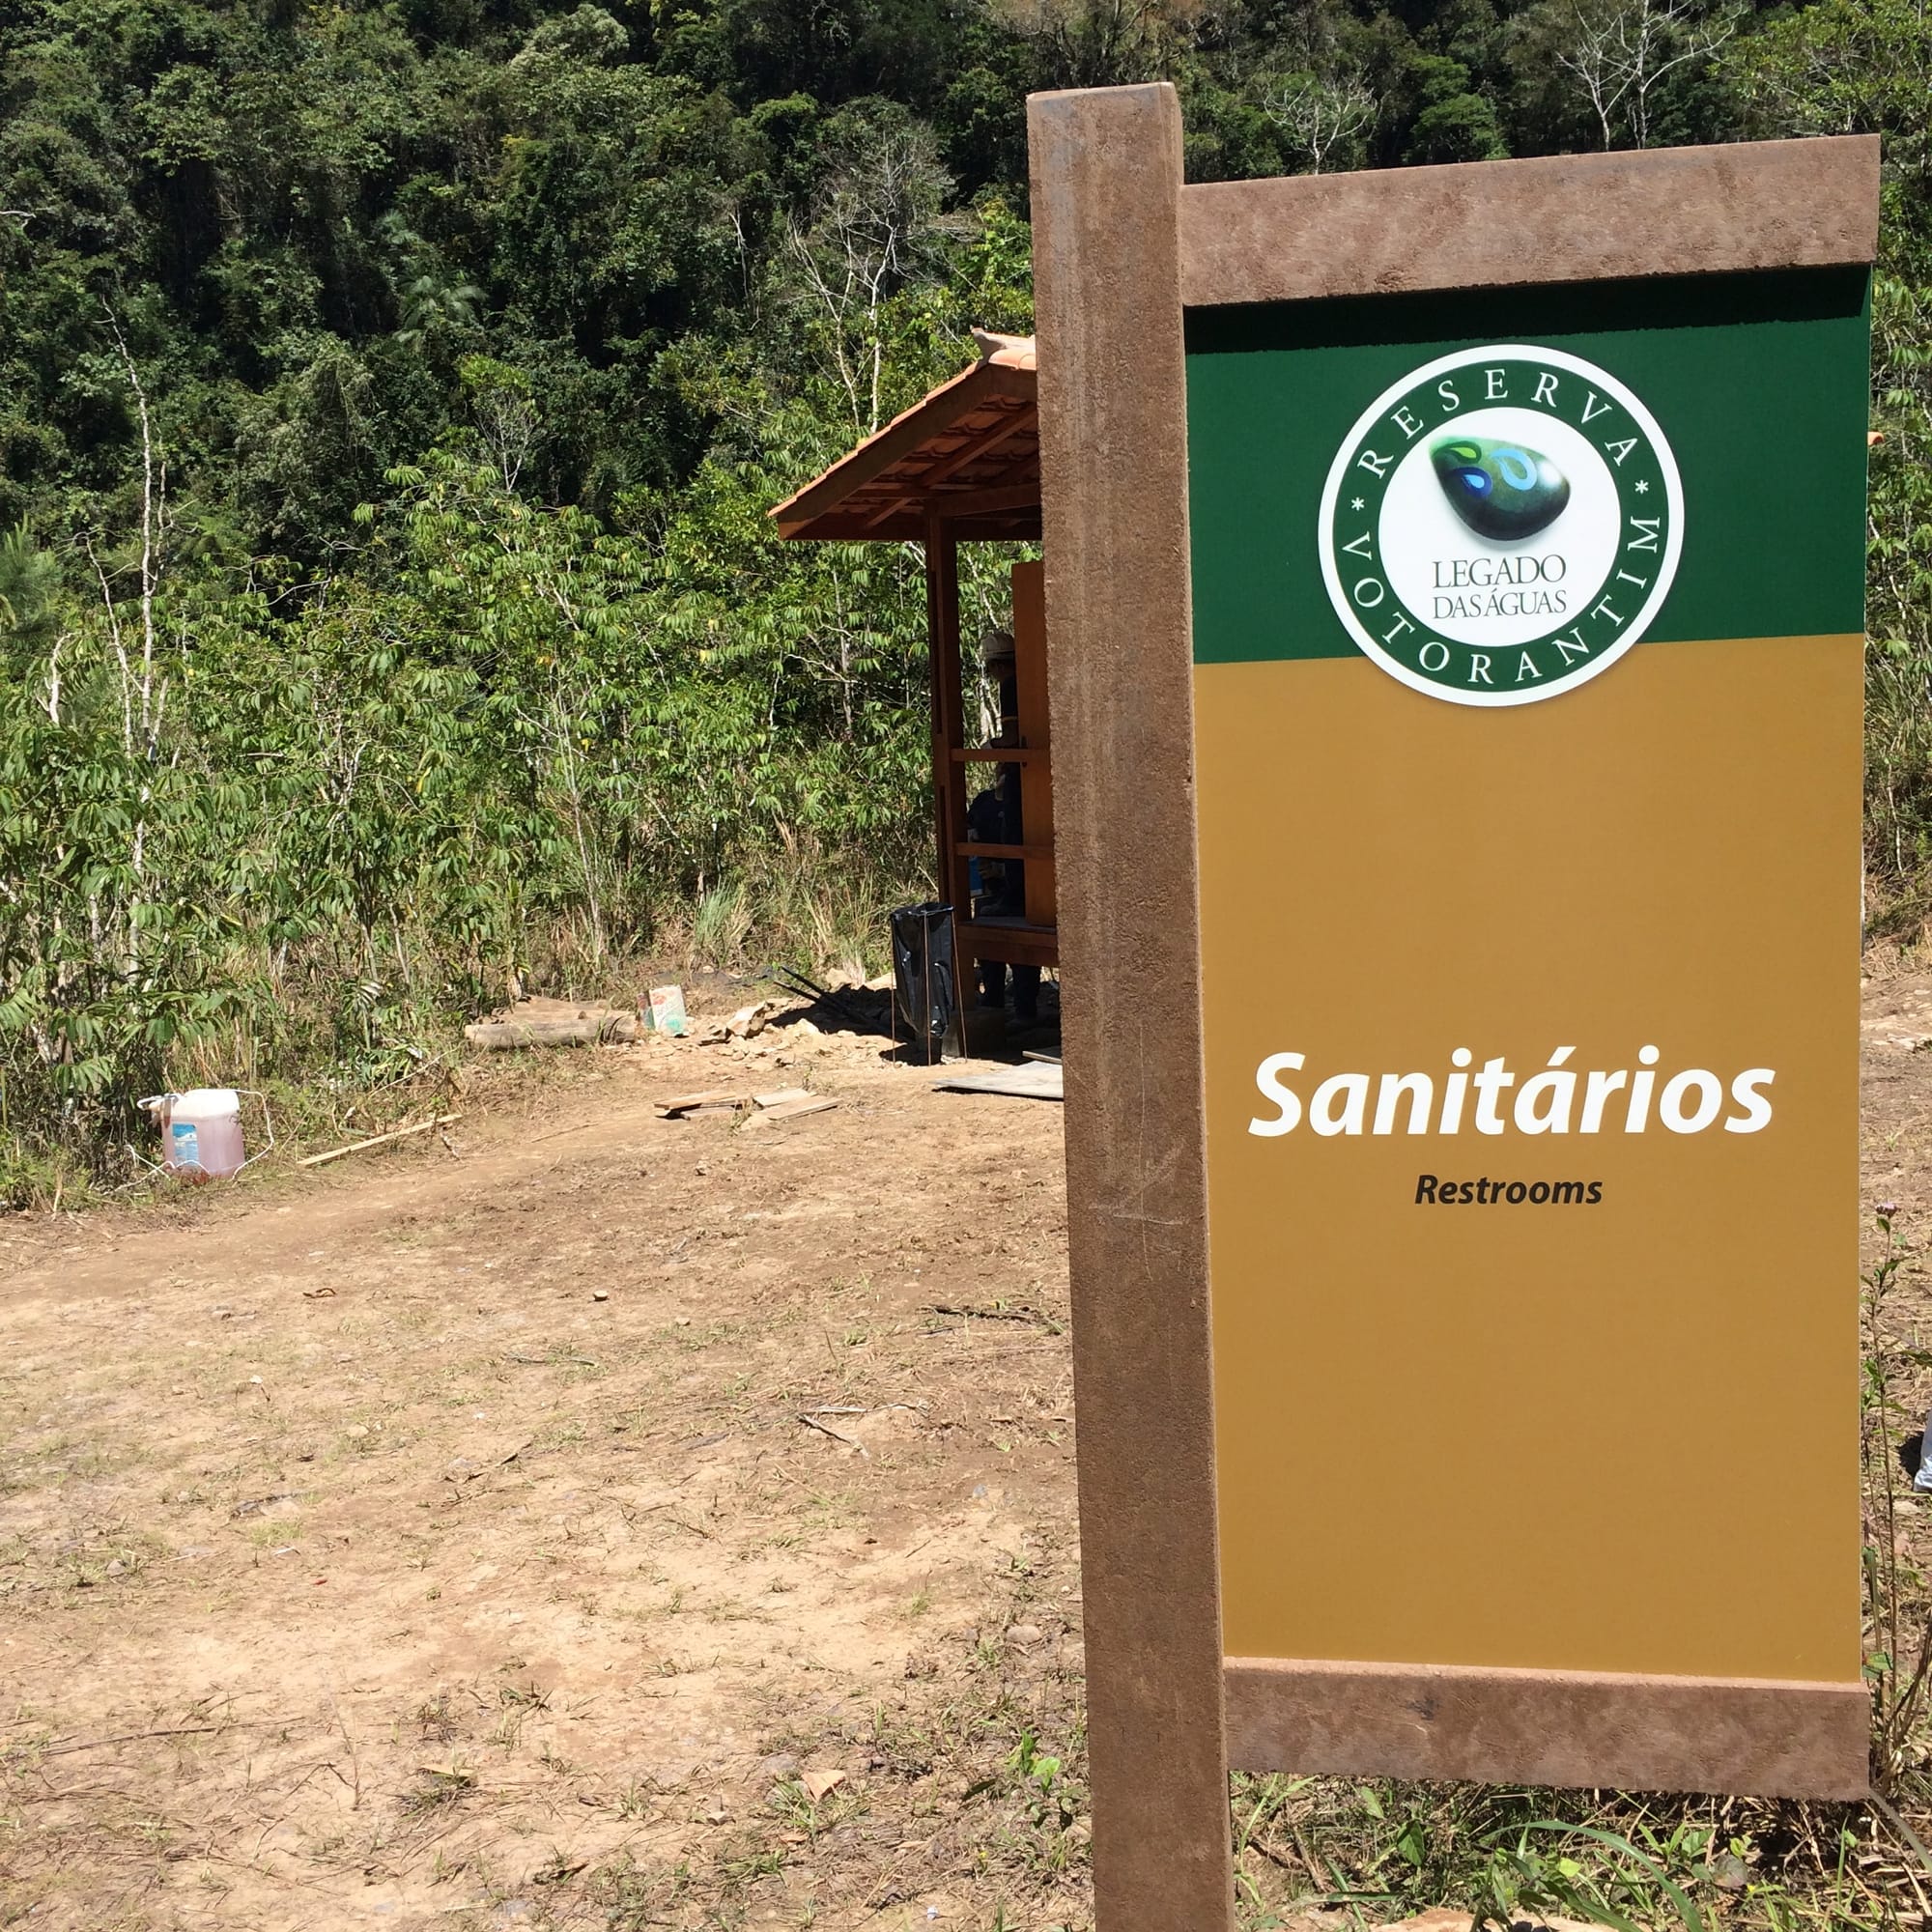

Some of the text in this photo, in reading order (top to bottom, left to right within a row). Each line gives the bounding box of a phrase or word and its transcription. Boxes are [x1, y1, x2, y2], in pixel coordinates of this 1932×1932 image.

[1357, 368, 1638, 479] RESERVA
[1342, 516, 1661, 684] VOTORANTIM
[1433, 554, 1567, 588] LEGADO
[1248, 1044, 1776, 1137] Sanitários
[1415, 1175, 1603, 1205] Restrooms
